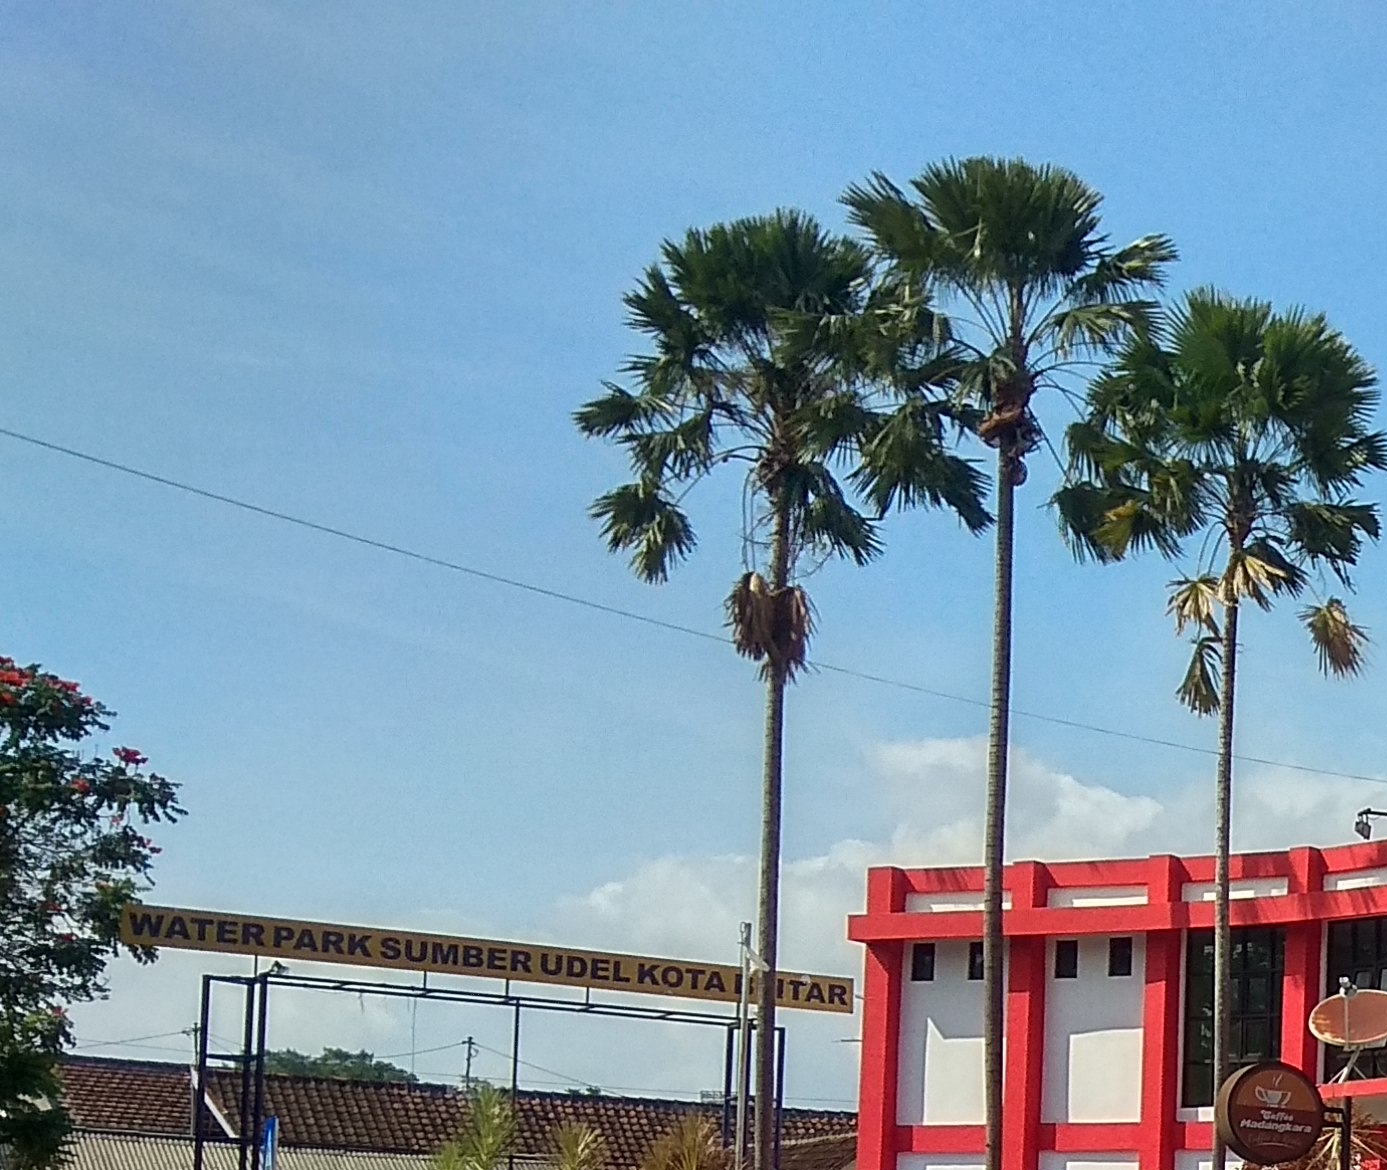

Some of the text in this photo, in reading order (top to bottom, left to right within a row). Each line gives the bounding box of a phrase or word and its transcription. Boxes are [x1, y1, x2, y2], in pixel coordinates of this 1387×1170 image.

[128, 911, 848, 1006] WATER PARK SUMBER UDEL KOTA BITAR
